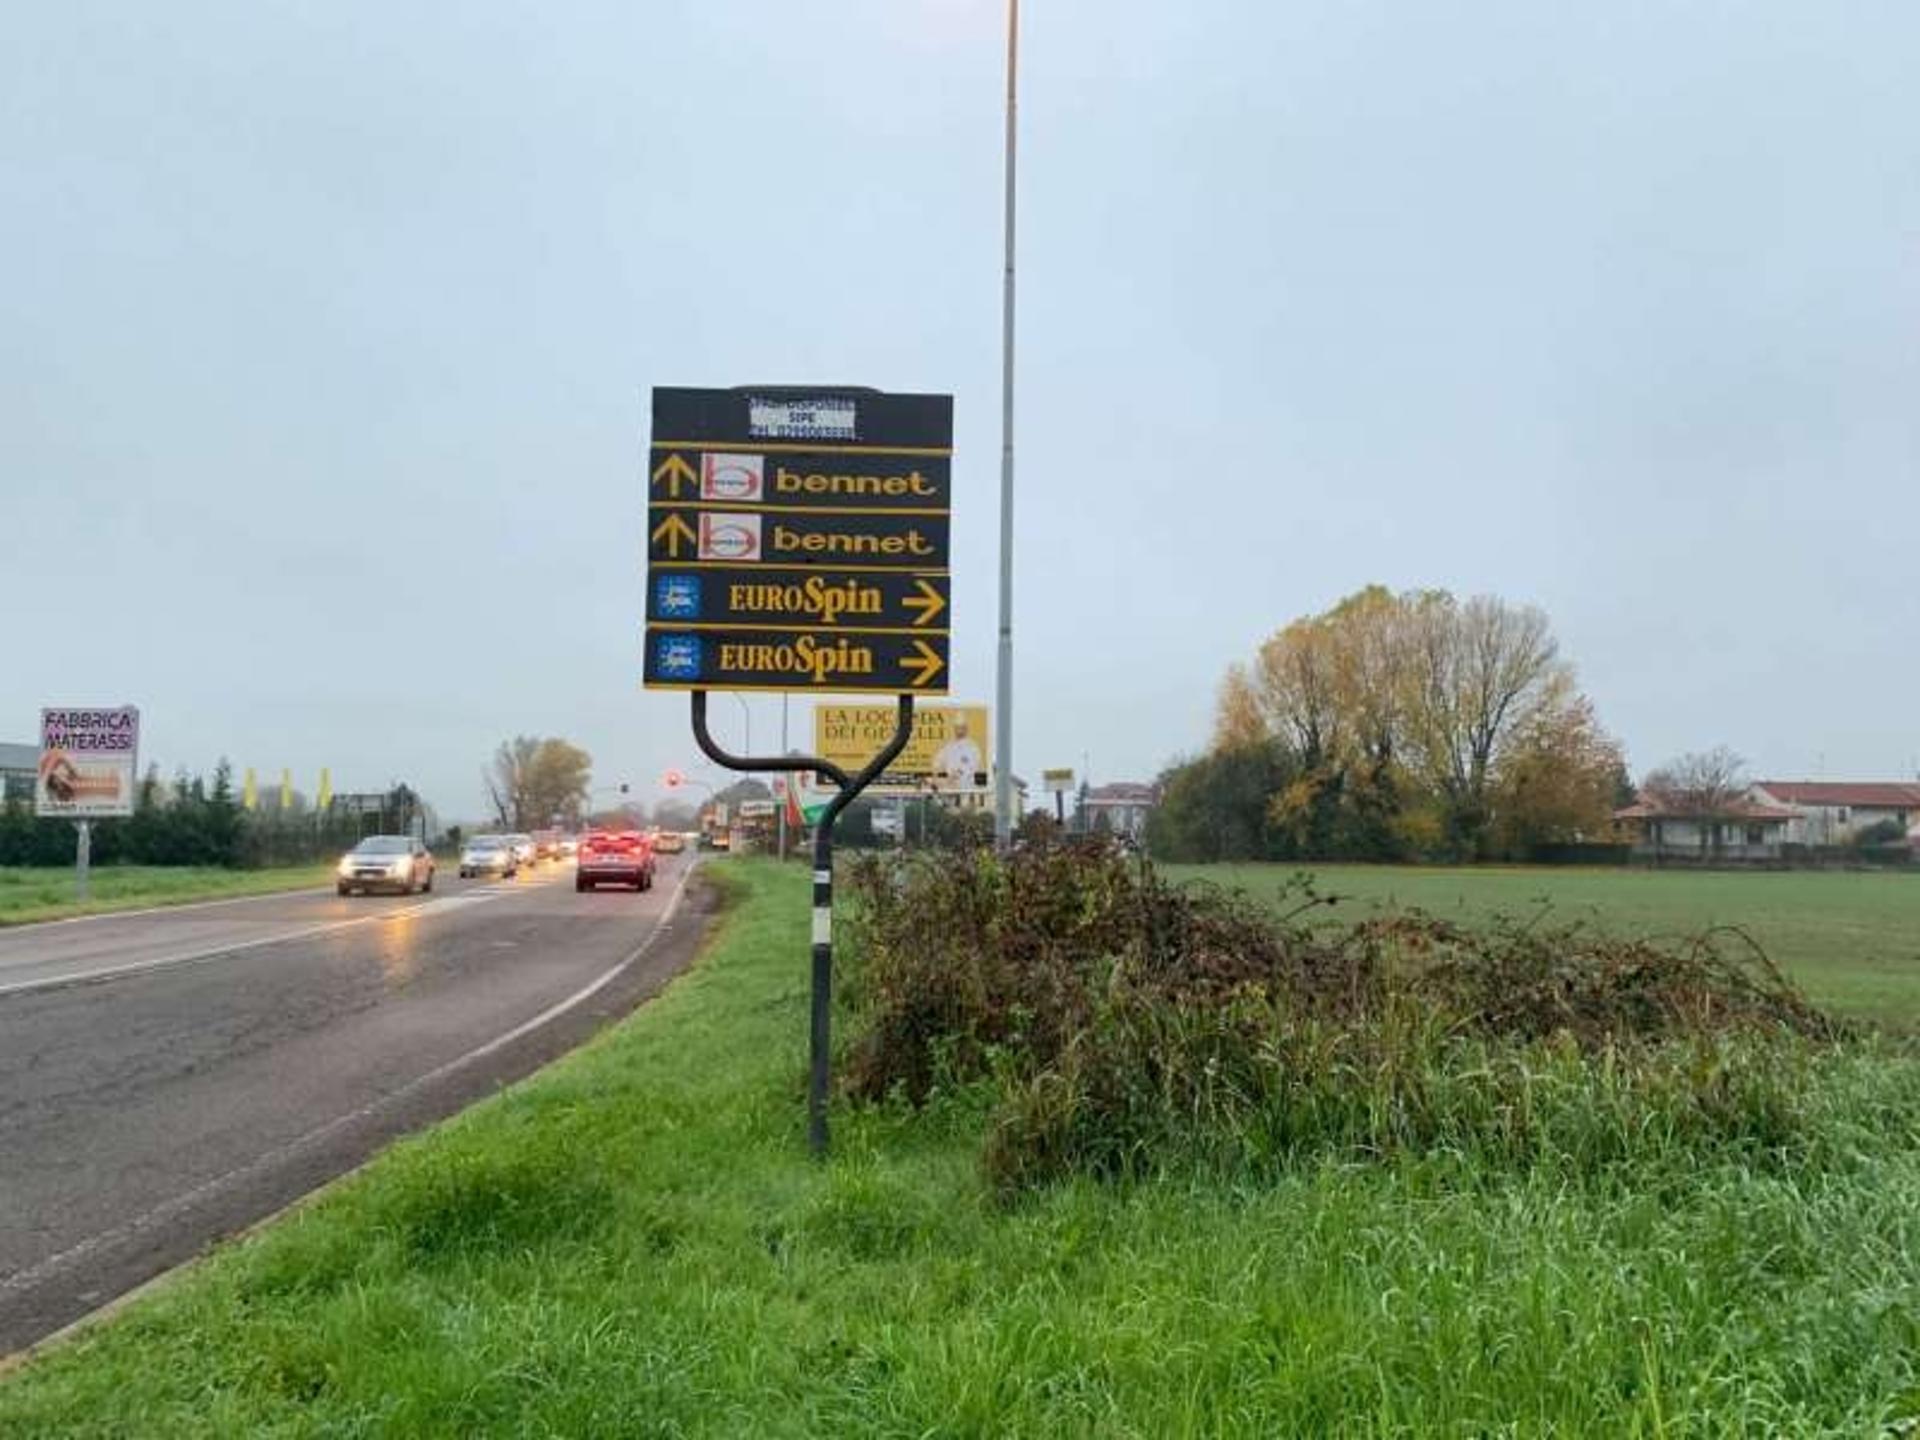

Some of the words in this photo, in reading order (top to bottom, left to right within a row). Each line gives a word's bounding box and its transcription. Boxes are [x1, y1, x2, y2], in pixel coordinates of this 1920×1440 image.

[788, 411, 816, 423] SIPE
[776, 467, 937, 496] bennet
[773, 525, 934, 555] bennet
[45, 712, 131, 729] FABBRICA
[825, 710, 847, 724] LA
[856, 710, 945, 725] LOCDA
[45, 733, 133, 749] MATERASSI
